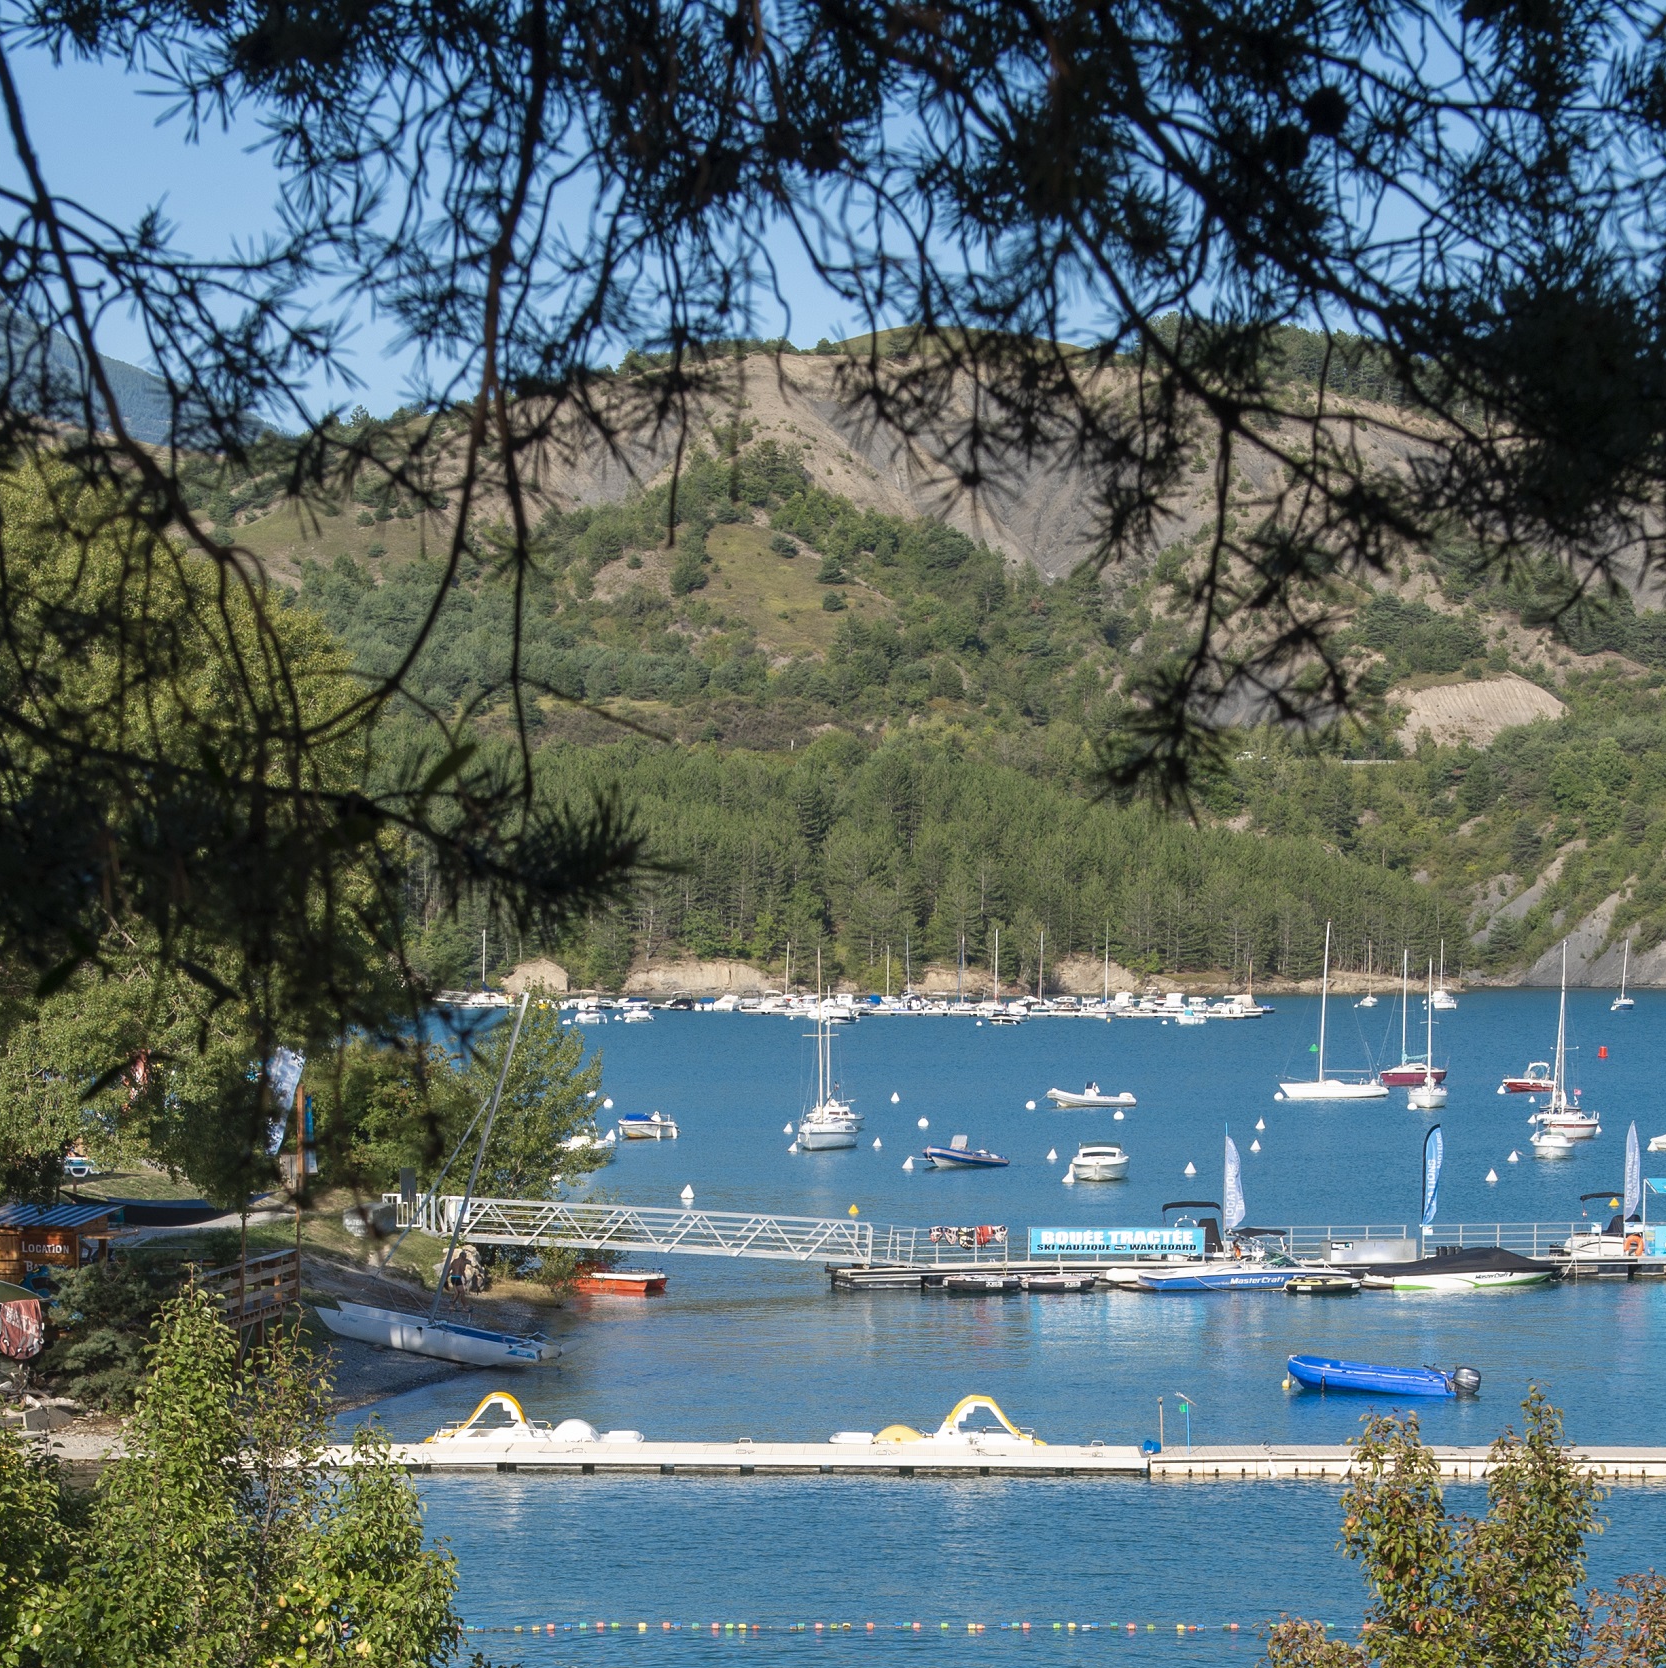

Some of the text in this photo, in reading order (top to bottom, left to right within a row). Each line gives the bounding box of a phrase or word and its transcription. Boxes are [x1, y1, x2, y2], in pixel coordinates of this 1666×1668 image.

[1435, 1131, 1444, 1169] MOTEURS
[1041, 1229, 1194, 1245] BOUÉE TRACTÉE
[22, 1240, 70, 1254] LOCATION
[1230, 1276, 1284, 1285] MasterCraft
